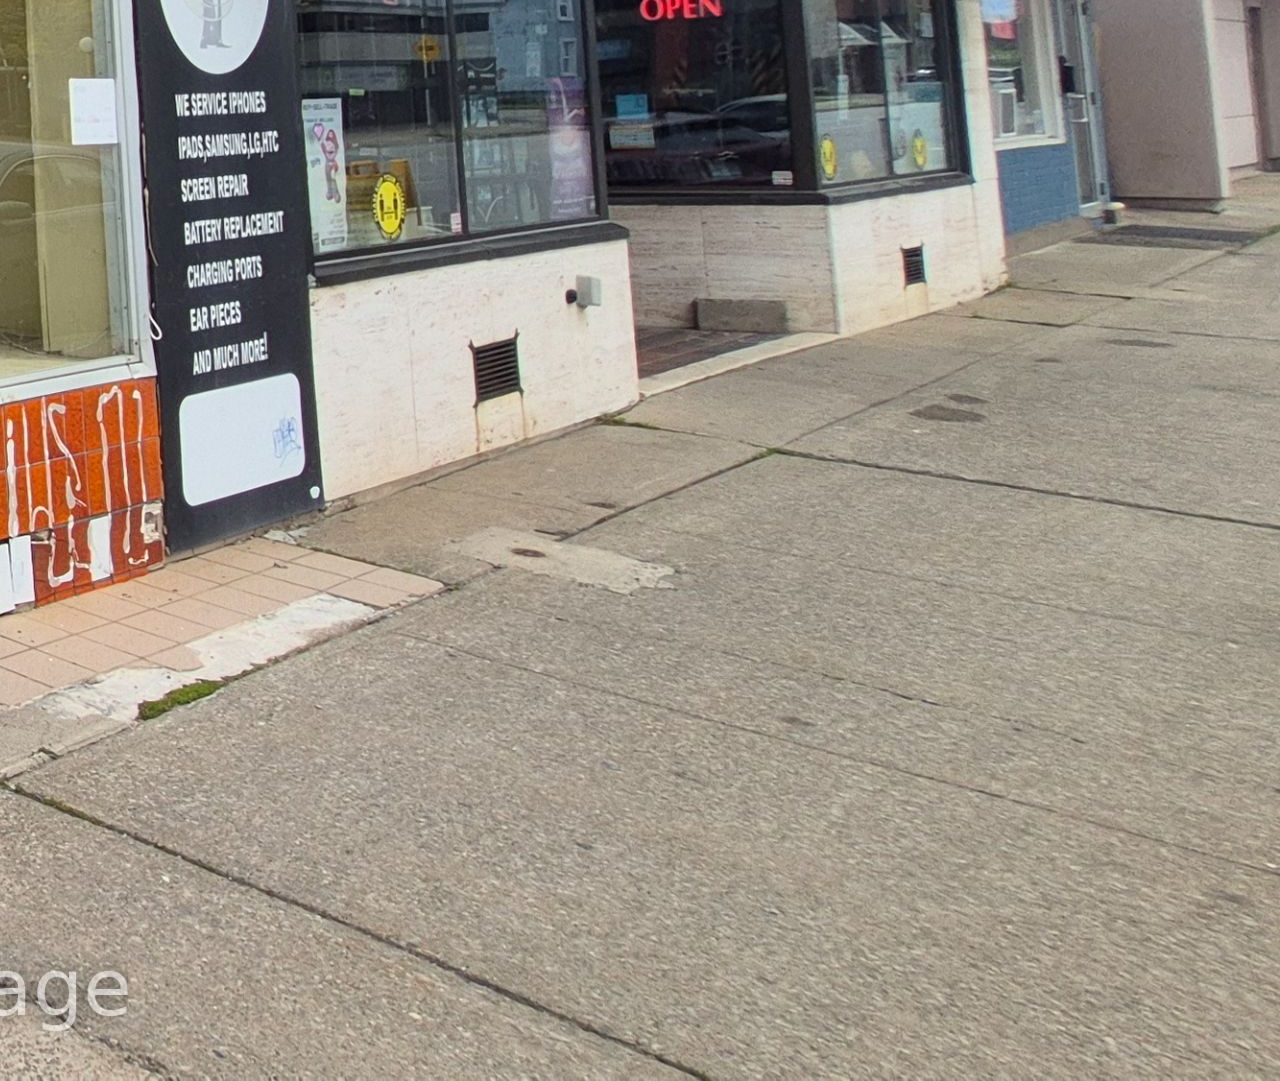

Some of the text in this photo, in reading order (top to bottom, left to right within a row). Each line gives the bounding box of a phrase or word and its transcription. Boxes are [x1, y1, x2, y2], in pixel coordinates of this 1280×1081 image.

[175, 91, 267, 117] WE SERVICE IPHONES
[181, 173, 249, 203] SCREEN REPAIR
[183, 210, 284, 246] BATTERY REPLACEMENT
[187, 255, 263, 289] CHARGING PORTS
[190, 300, 242, 332] EAR PIECES
[193, 331, 269, 376] AND MUCH MORE!
